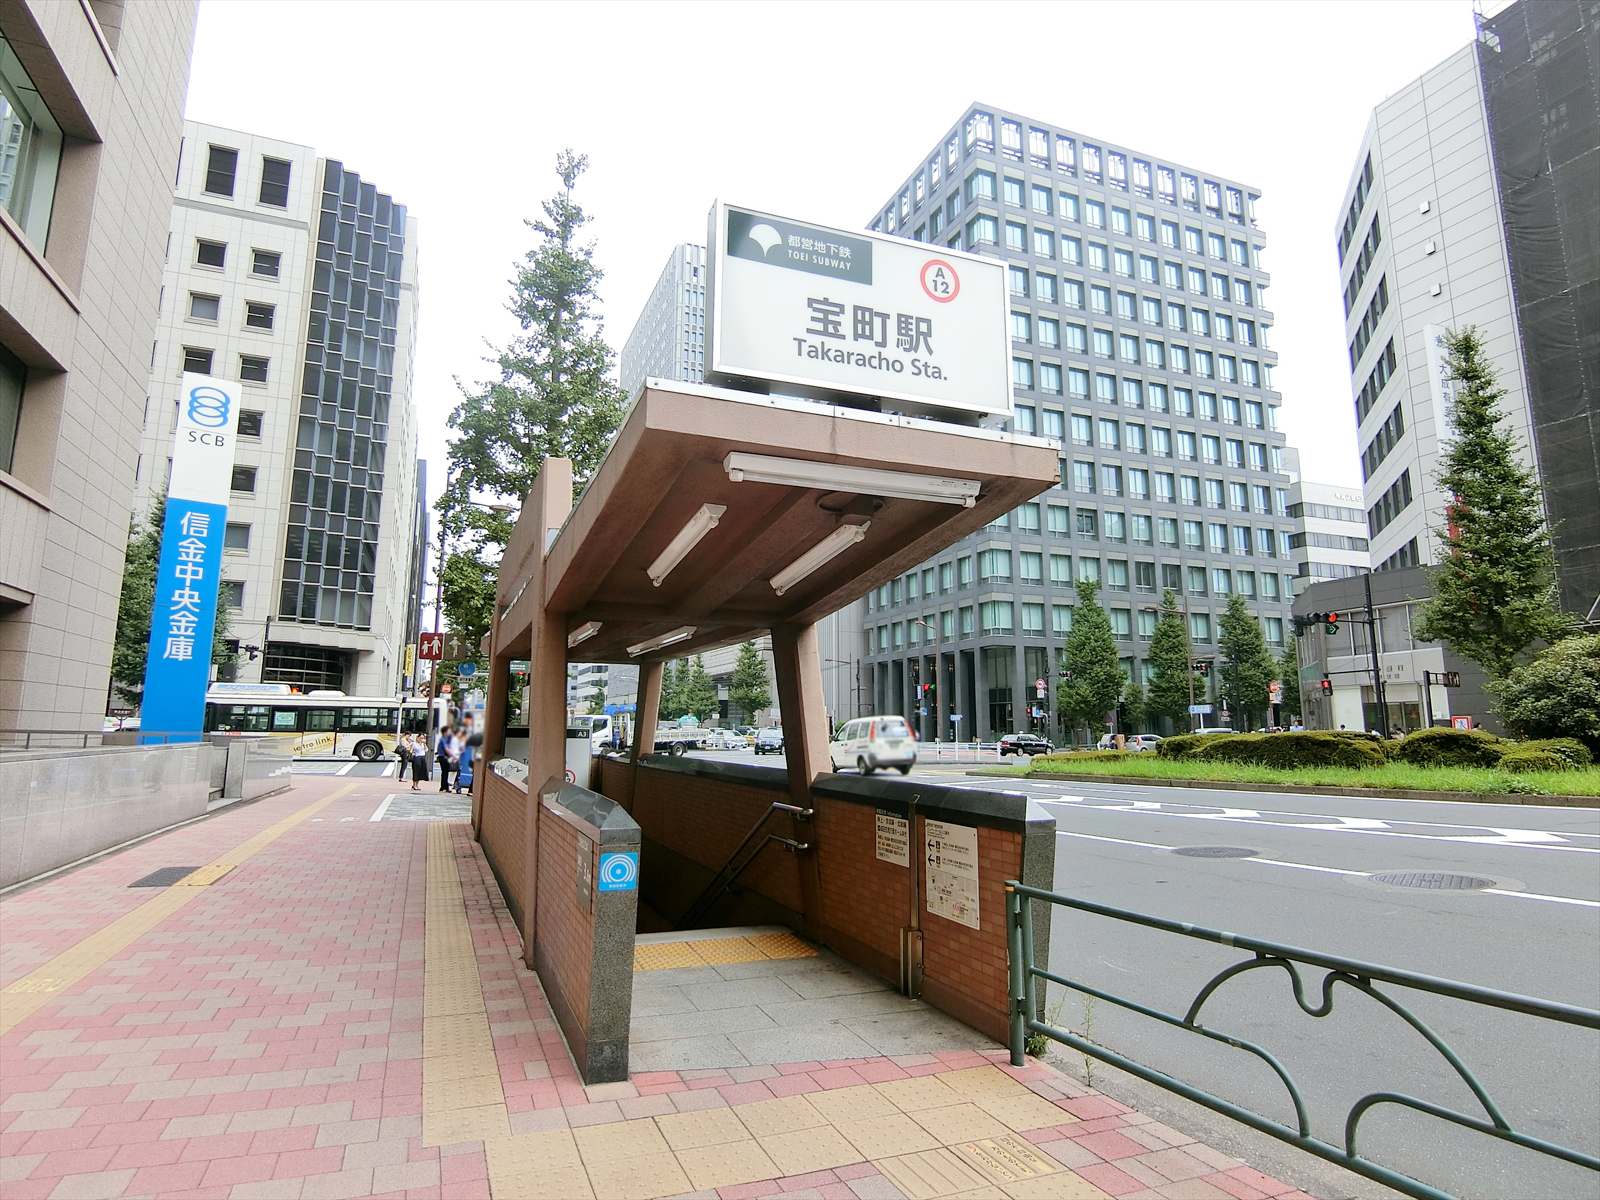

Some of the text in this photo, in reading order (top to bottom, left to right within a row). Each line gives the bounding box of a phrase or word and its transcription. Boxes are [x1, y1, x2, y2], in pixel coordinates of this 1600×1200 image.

[788, 235, 851, 259] 都営地下鉄
[788, 250, 851, 270] TOEI SUBWAY
[935, 267, 945, 279] A
[932, 279, 949, 294] 12
[806, 297, 934, 356] 宝町駅
[793, 337, 948, 380] Takaracho Sta.
[188, 431, 225, 447] SCB
[163, 511, 211, 661] 信金中央金庫
[315, 736, 332, 745] link
